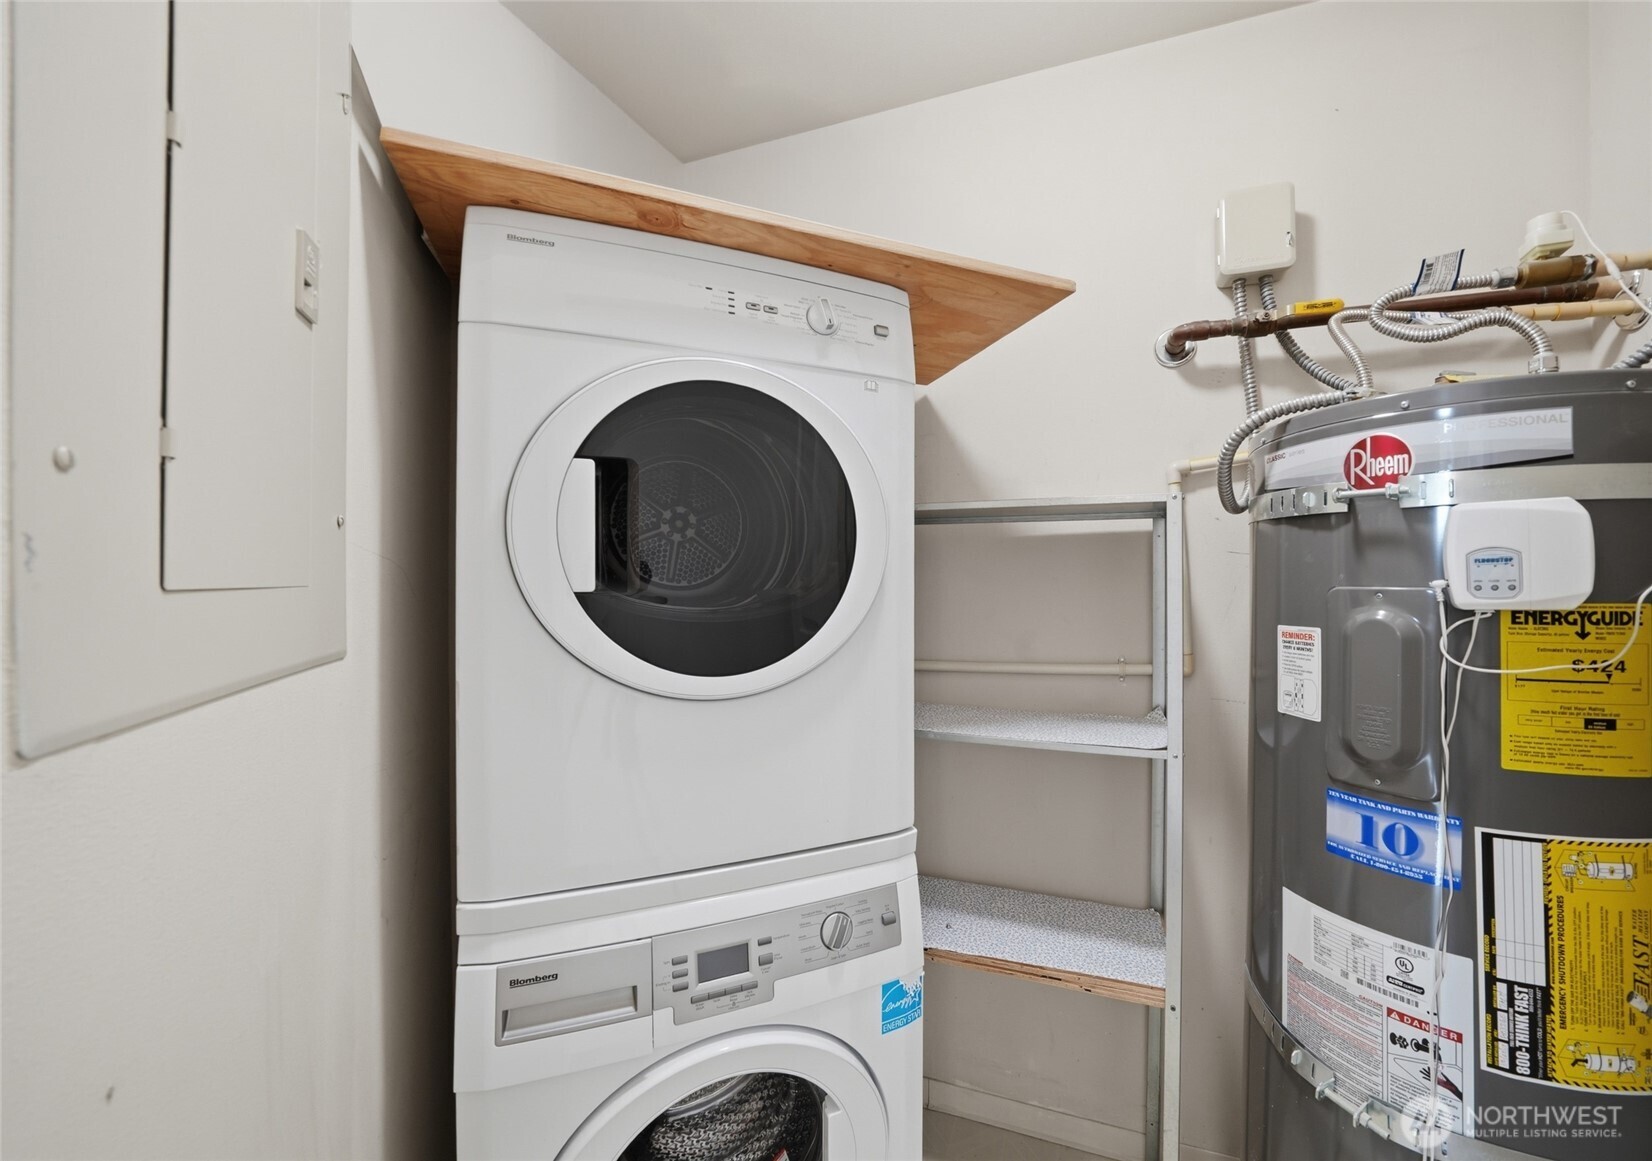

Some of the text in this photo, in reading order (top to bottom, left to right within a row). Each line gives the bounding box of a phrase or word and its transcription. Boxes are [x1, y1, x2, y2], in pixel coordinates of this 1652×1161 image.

[506, 234, 554, 248] Blomberg
[1266, 452, 1286, 464] CLASSIC
[1350, 437, 1409, 486] Rheem
[1282, 632, 1316, 641] REMINDER:
[1340, 794, 1357, 802] YEAR
[1358, 798, 1376, 808] TANK
[1392, 807, 1416, 816] PARTS
[1417, 812, 1460, 825] WARRNTY
[1355, 812, 1419, 857] 10
[1350, 854, 1369, 864] CALL
[1400, 960, 1410, 970] UL
[1556, 895, 1567, 1030] EMERGENCY SHUTDOWN PROCEDURES
[1632, 934, 1649, 988] FAST
[510, 973, 558, 988] Blomberg
[883, 1016, 907, 1032] ENERGY
[1514, 985, 1530, 1075] 800-THINK FAST
